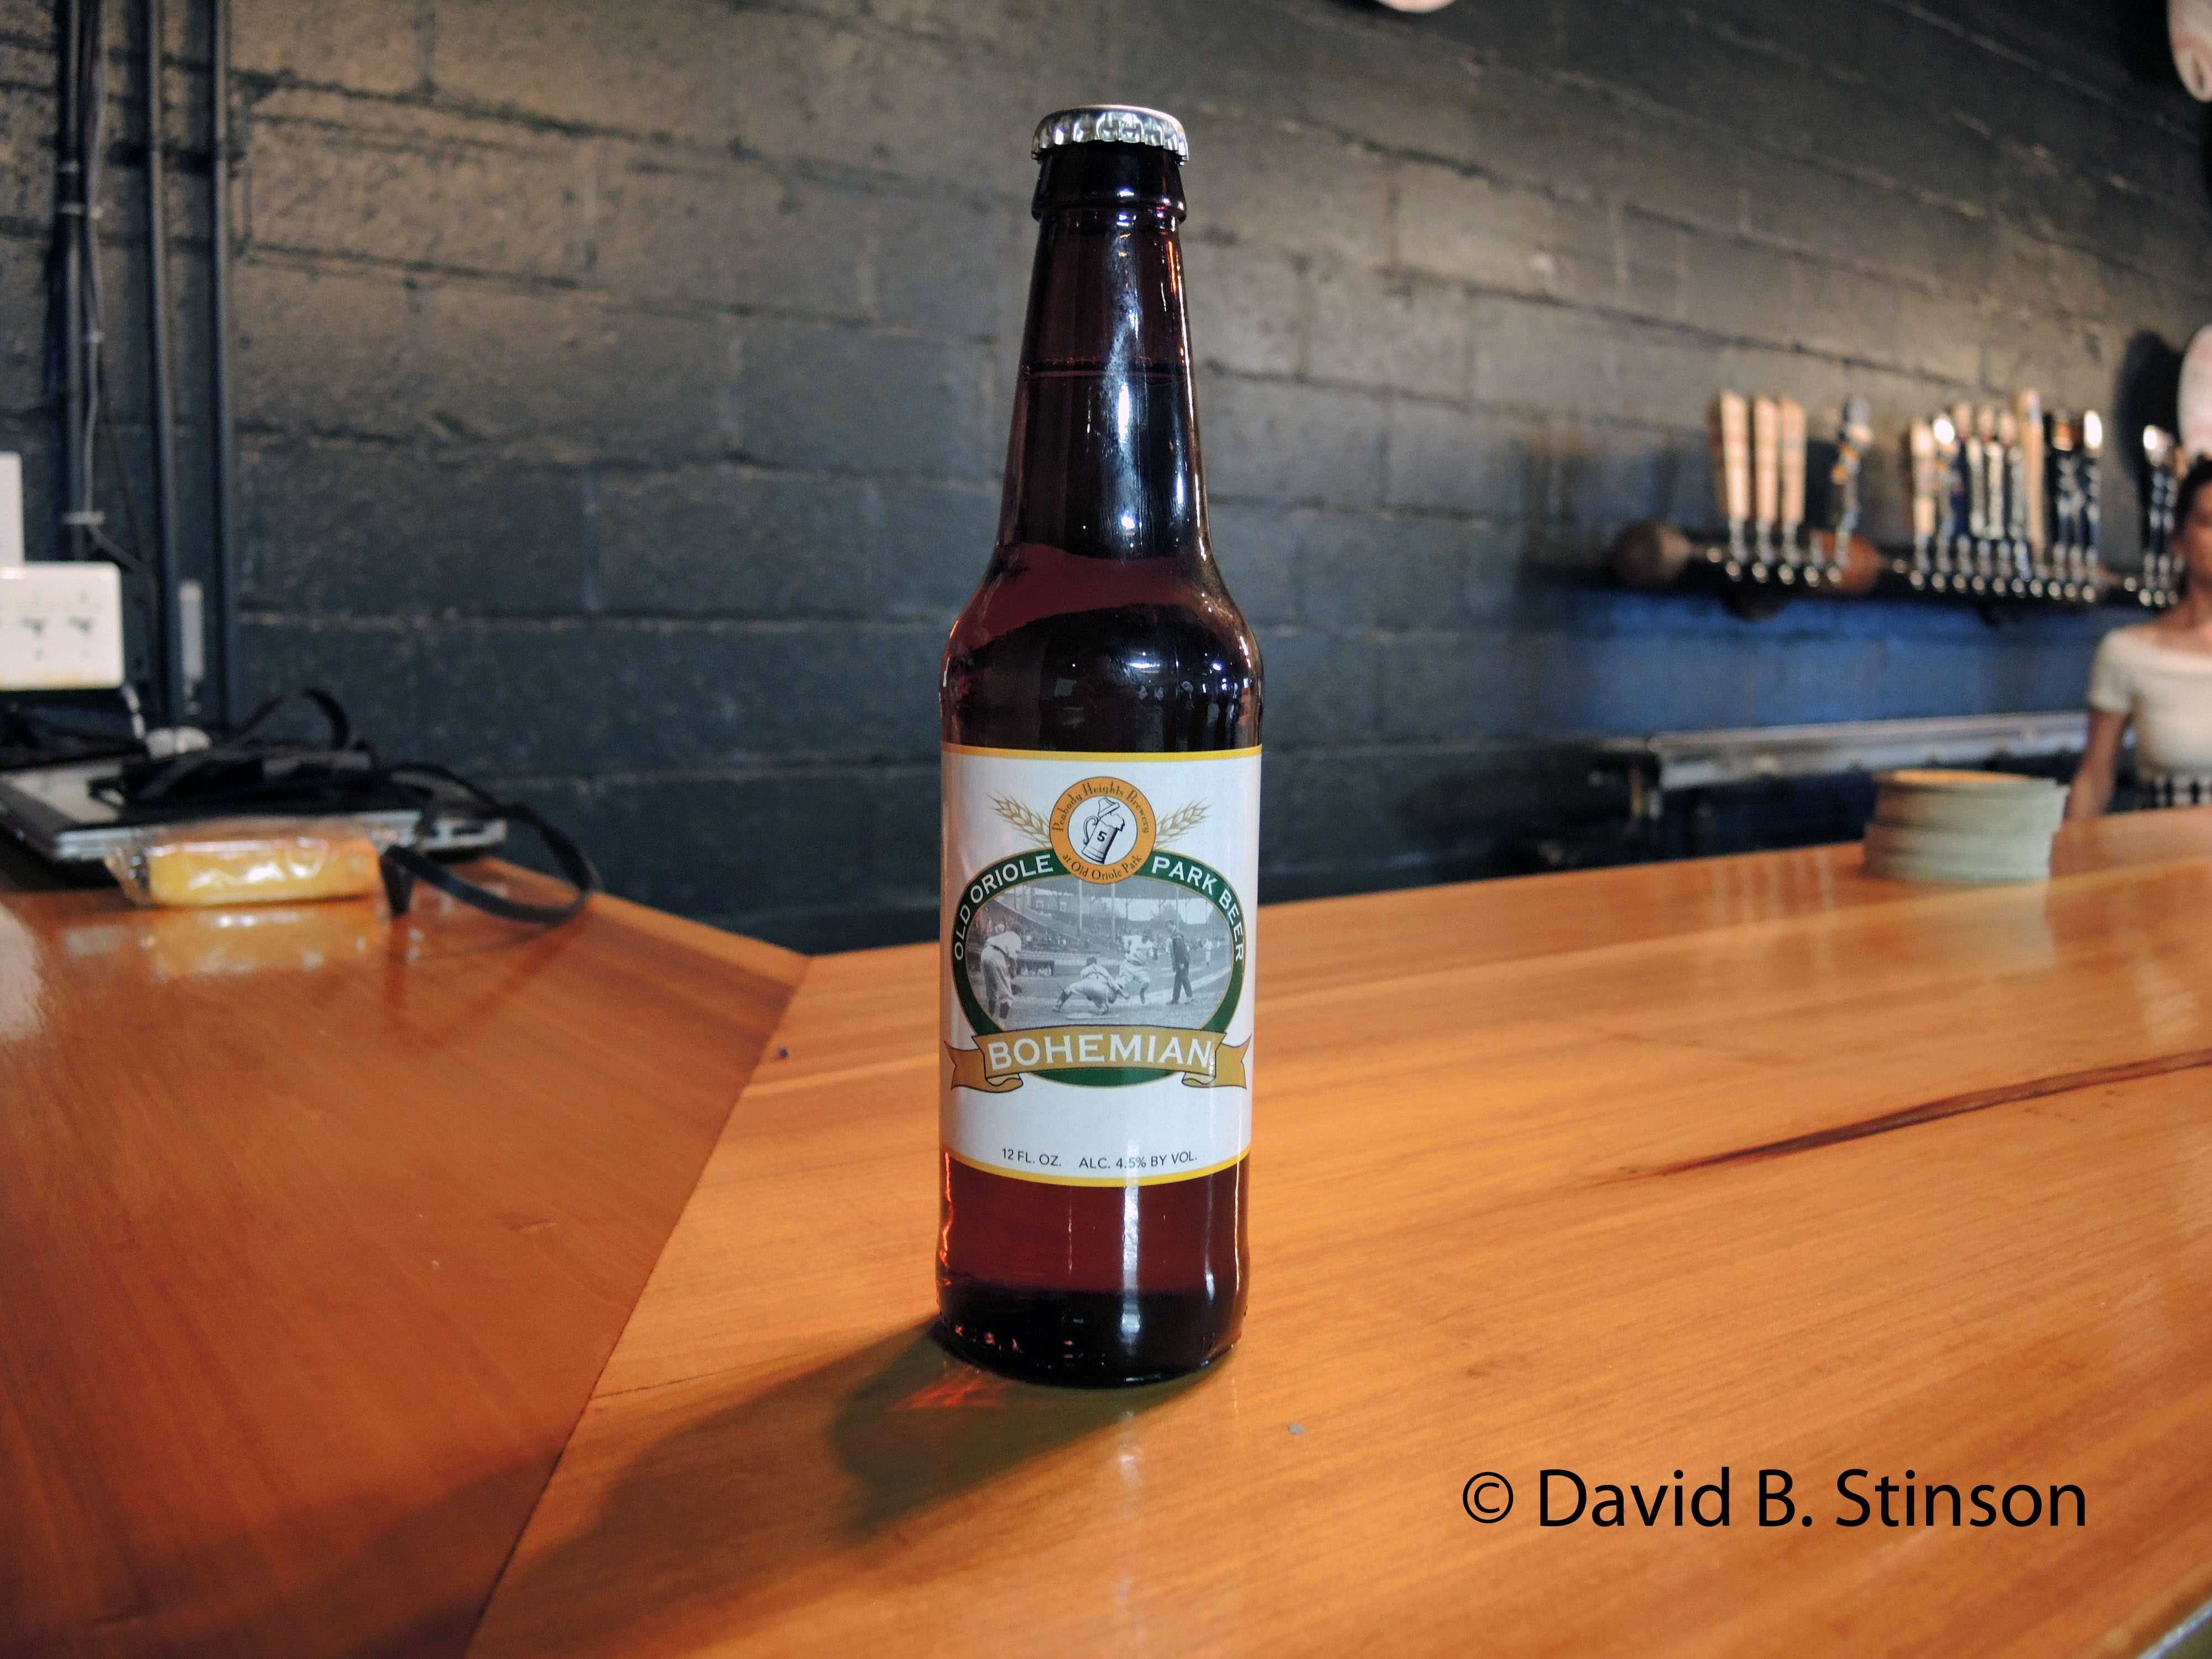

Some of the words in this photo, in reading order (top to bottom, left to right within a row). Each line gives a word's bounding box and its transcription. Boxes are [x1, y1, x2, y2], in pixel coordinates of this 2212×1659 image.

[1052, 794, 1082, 831] Peabody
[1082, 781, 1123, 796] Heights
[1126, 790, 1149, 833] Brewery
[1097, 831, 1107, 842] 5
[1062, 854, 1071, 863] at
[1071, 861, 1089, 877] Old
[1092, 869, 1122, 880] Oriole
[1122, 855, 1142, 873] Park
[954, 907, 971, 961] OLD
[970, 854, 1053, 905] ORIOLE
[1151, 855, 1218, 895] PARK
[1218, 889, 1244, 961] BEER
[988, 1034, 1211, 1070] BOHEMIAN
[1002, 1148, 1014, 1160] 12
[1018, 1151, 1035, 1164] FL.
[1039, 1154, 1062, 1167] OZ.
[1079, 1157, 1110, 1168] ALC.
[1115, 1156, 1146, 1168] 4.5%
[1150, 1155, 1167, 1167] BY
[1171, 1151, 1197, 1164] VOL.
